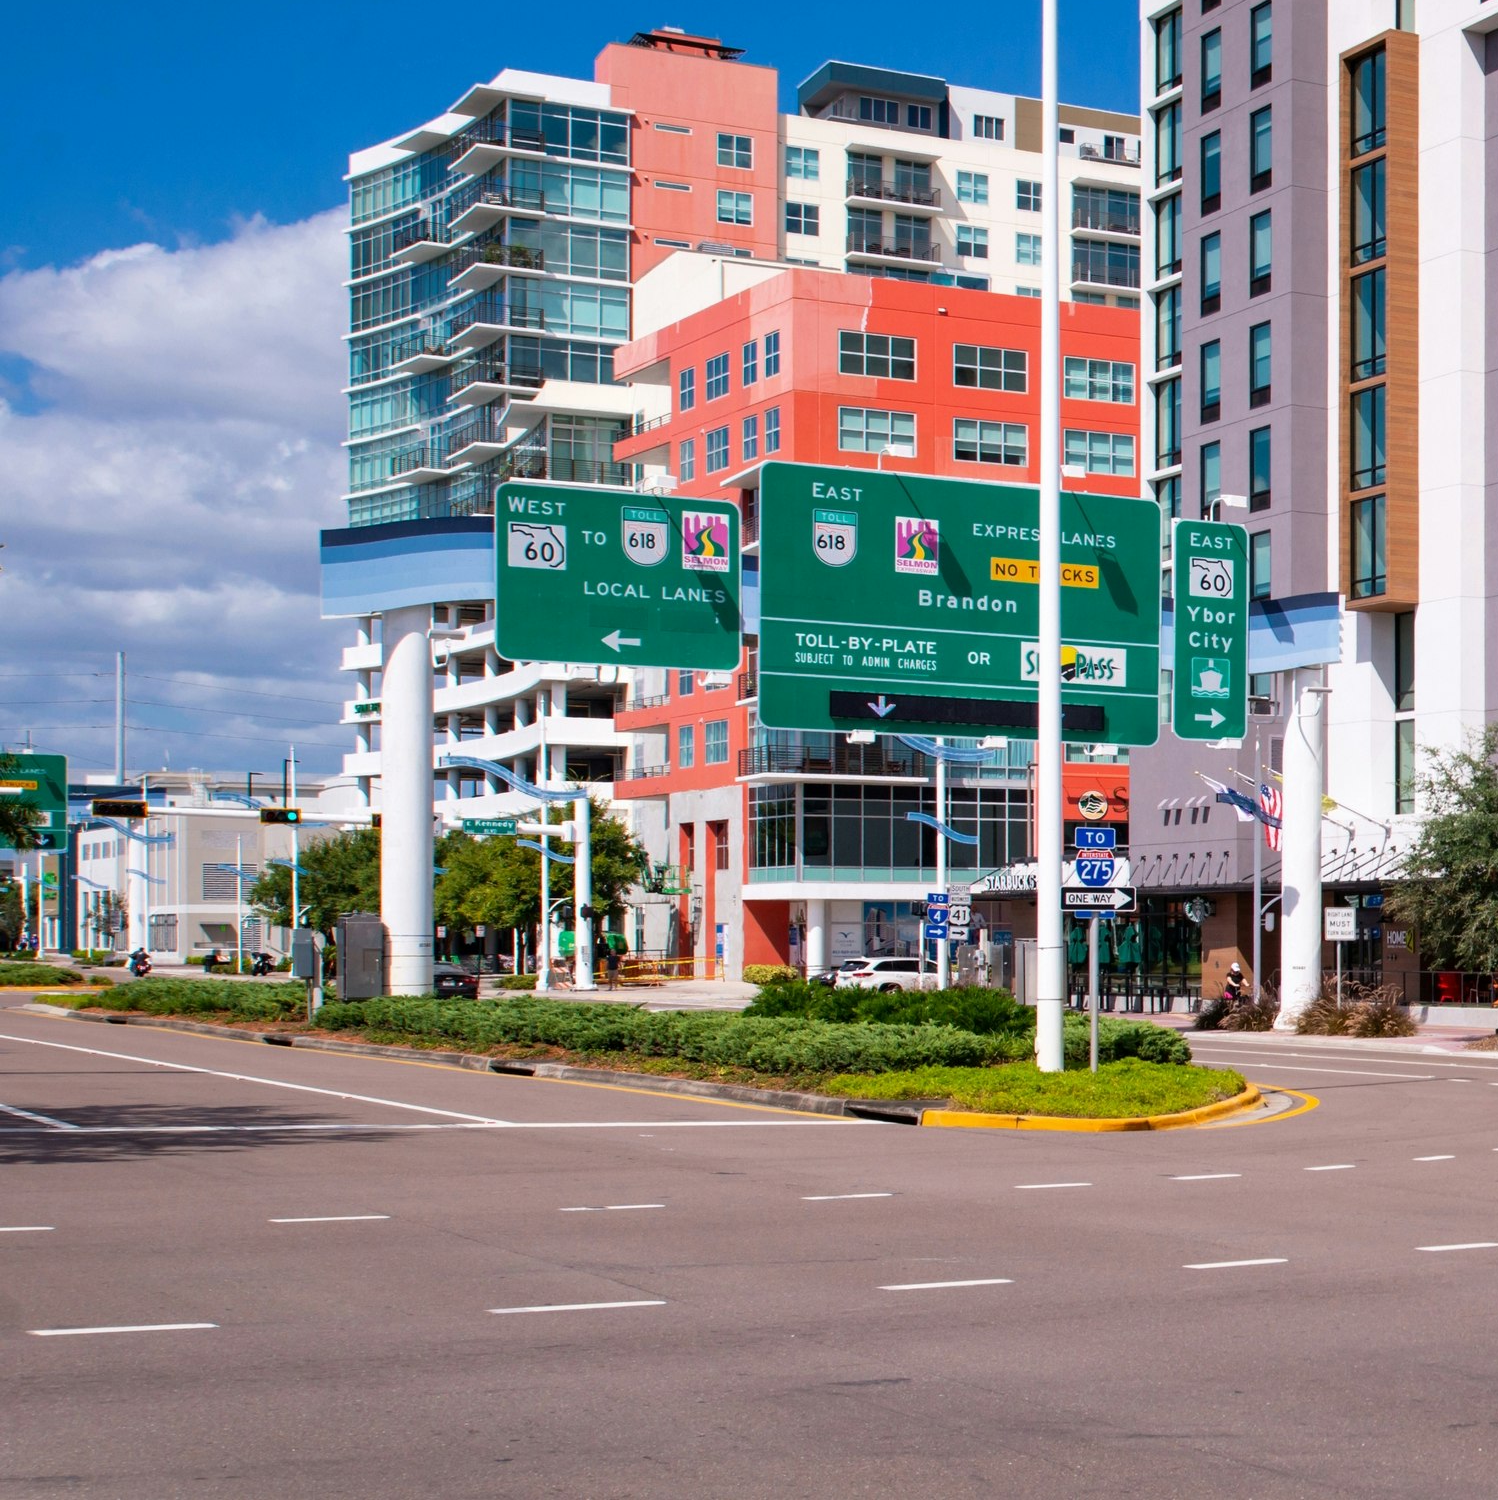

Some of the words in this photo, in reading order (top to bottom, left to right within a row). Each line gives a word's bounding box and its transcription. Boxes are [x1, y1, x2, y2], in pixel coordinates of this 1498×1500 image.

[812, 482, 863, 501] EAST
[508, 496, 566, 516] WEST
[630, 510, 660, 521] TOLL
[822, 512, 848, 523] TOLL
[582, 530, 607, 546] TO
[629, 533, 656, 549] 618
[817, 534, 846, 551] 618
[973, 523, 1040, 542] EXPRES
[1061, 532, 1116, 548] LANES
[1190, 532, 1233, 550] EAST
[525, 541, 555, 562] 60
[684, 556, 728, 565] SELMON
[896, 559, 937, 569] SELMON
[995, 563, 1018, 577] NO
[1028, 566, 1095, 583] TCKS
[1200, 573, 1226, 592] 60
[583, 581, 650, 599] LOCAL
[662, 586, 725, 604] LANES
[919, 589, 1017, 613] Brandon
[1187, 605, 1236, 624] Ybor
[795, 633, 937, 655] TOLL-BY-PLATE
[967, 651, 991, 665] OR
[1188, 631, 1233, 653] City
[795, 652, 834, 665] SUBJECT
[842, 654, 853, 666] TO
[861, 656, 890, 668] ADMIN
[898, 658, 937, 671] CHARGES
[474, 820, 514, 829] Kennedy
[1085, 832, 1105, 844] TO
[1081, 860, 1112, 880] 275
[952, 884, 970, 892] SOUTH
[985, 875, 1037, 891] STARBUCKS
[932, 894, 944, 902] TO
[1068, 893, 1089, 904] ONE
[1093, 894, 1113, 904] WAY
[933, 911, 941, 922] 4
[952, 910, 966, 921] 41
[1387, 930, 1406, 945] HOME
